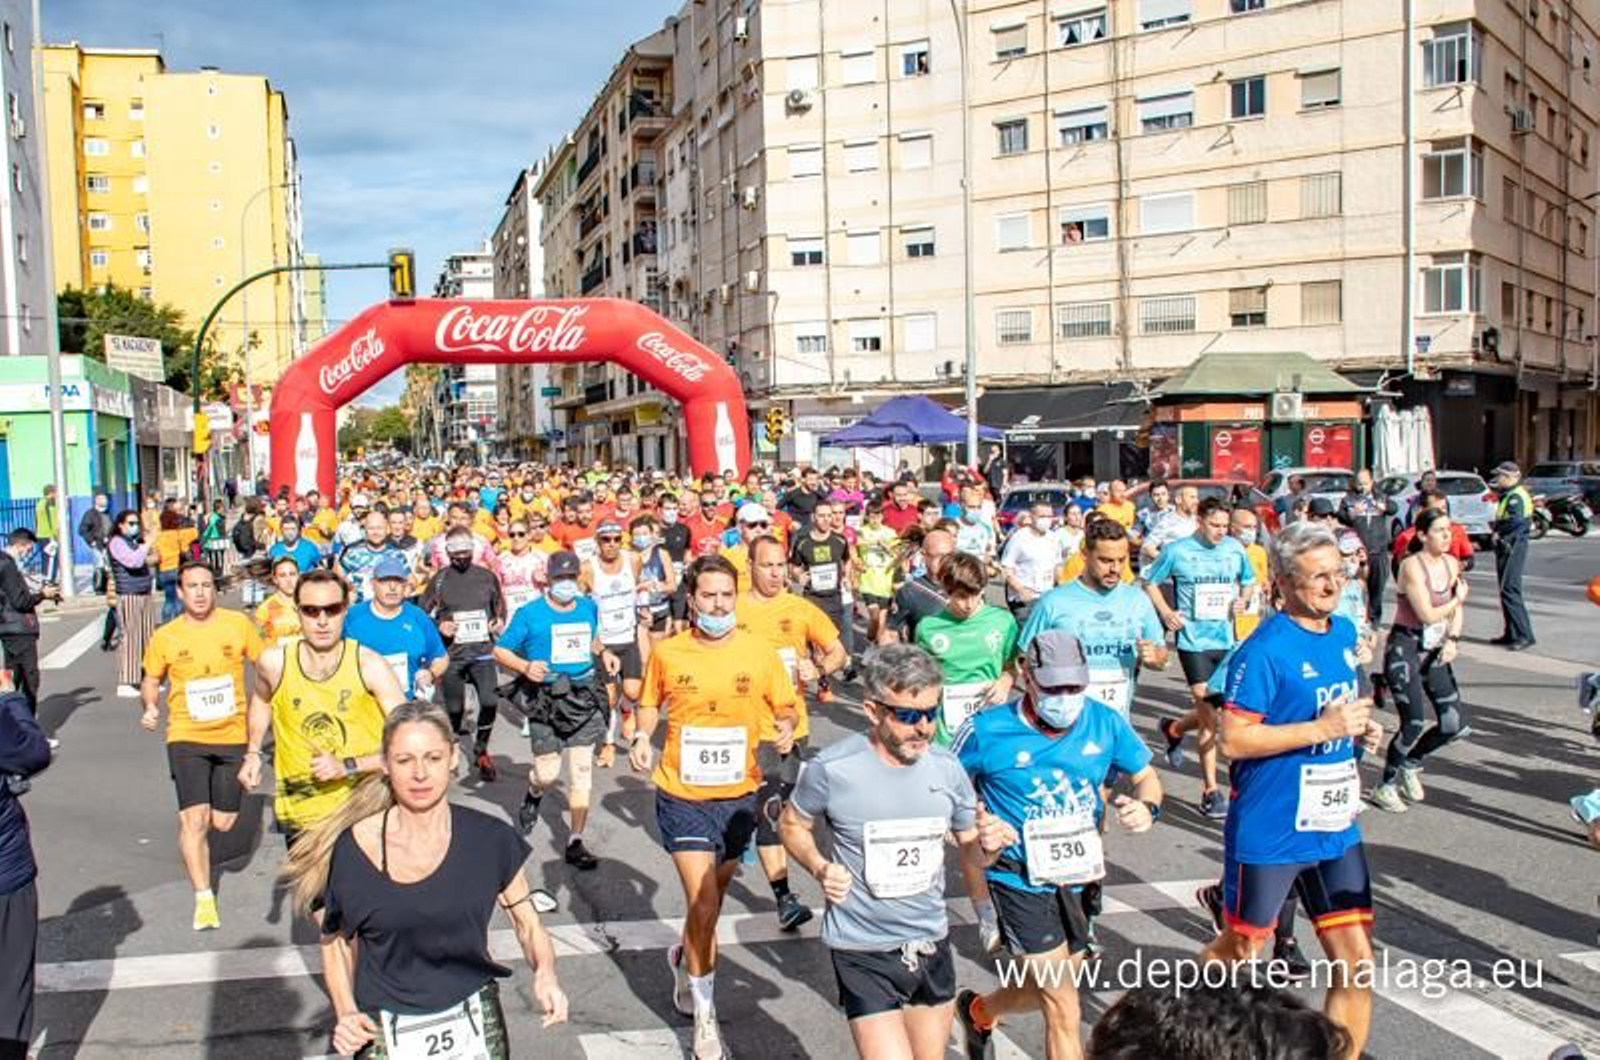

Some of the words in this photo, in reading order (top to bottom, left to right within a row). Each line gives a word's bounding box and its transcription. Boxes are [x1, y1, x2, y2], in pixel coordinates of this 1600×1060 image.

[434, 304, 590, 352] Coca-Cola
[201, 693, 225, 707] 100
[1101, 688, 1117, 701] 12
[700, 749, 730, 764] 615
[897, 847, 920, 867] 23
[1051, 841, 1085, 861] 530
[425, 1030, 455, 1056] 25
